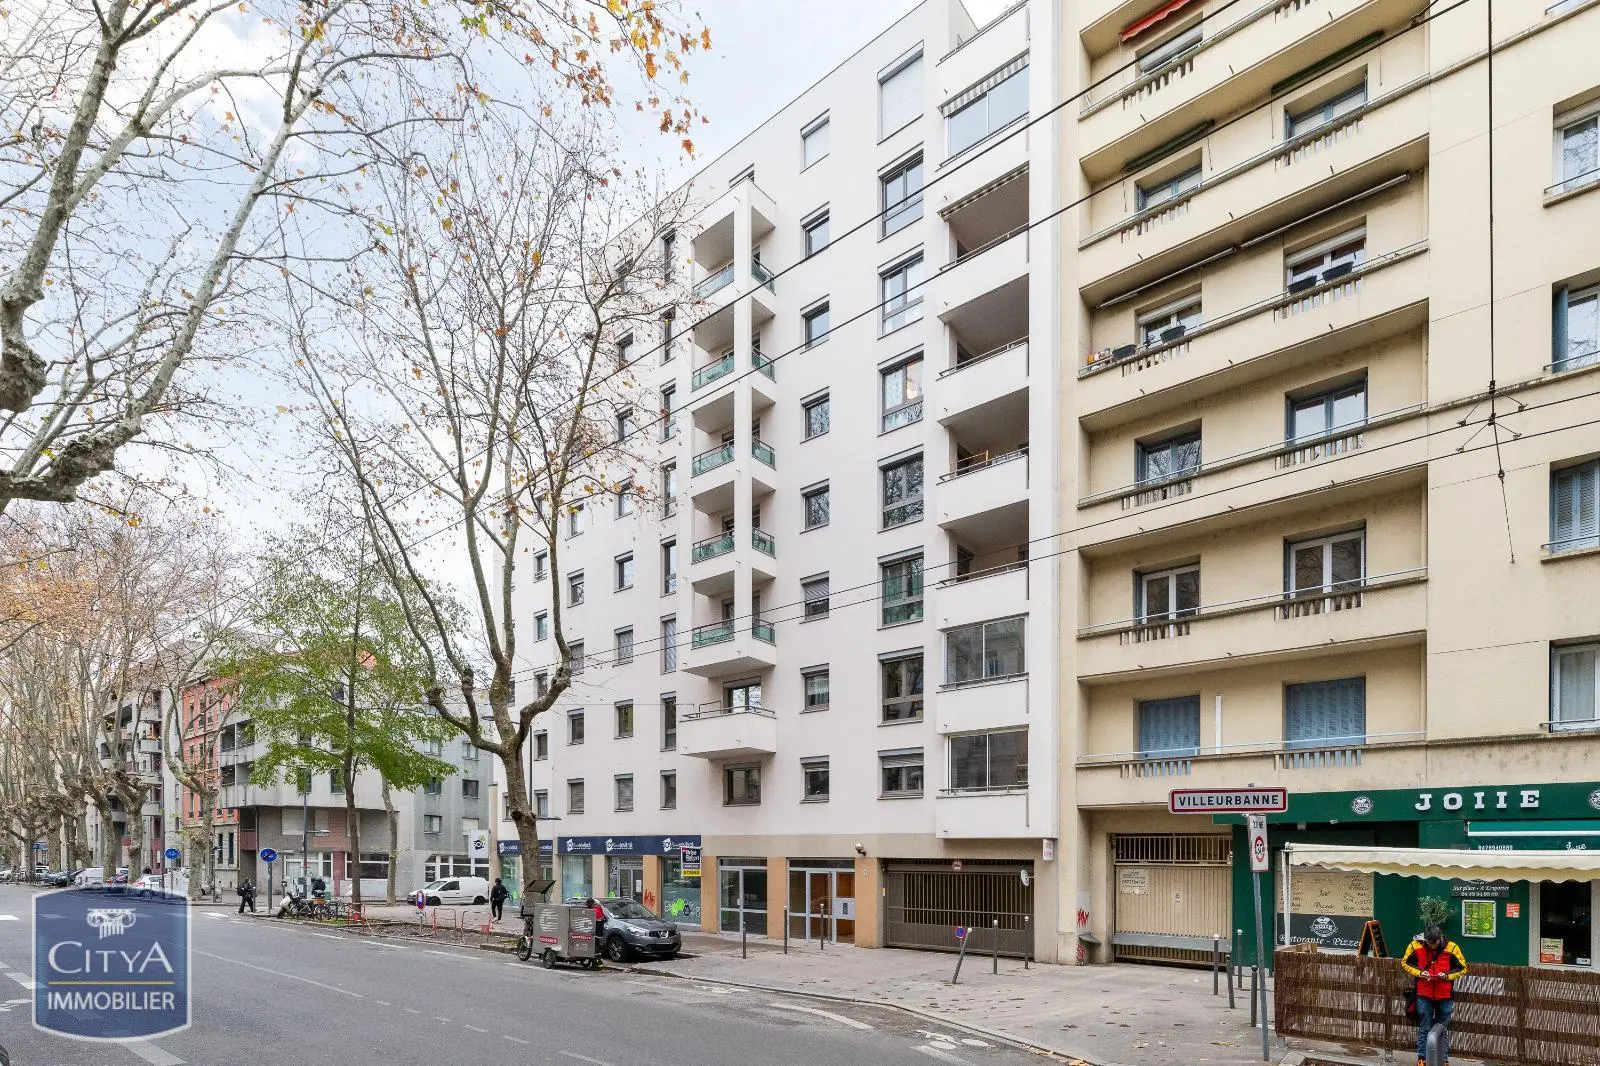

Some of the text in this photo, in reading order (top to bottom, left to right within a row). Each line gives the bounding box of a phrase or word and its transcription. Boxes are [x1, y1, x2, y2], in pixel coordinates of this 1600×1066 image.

[1179, 795, 1279, 806] VILLEURBANNE
[1414, 790, 1540, 811] JOIIE
[1280, 933, 1325, 945] Rstorante
